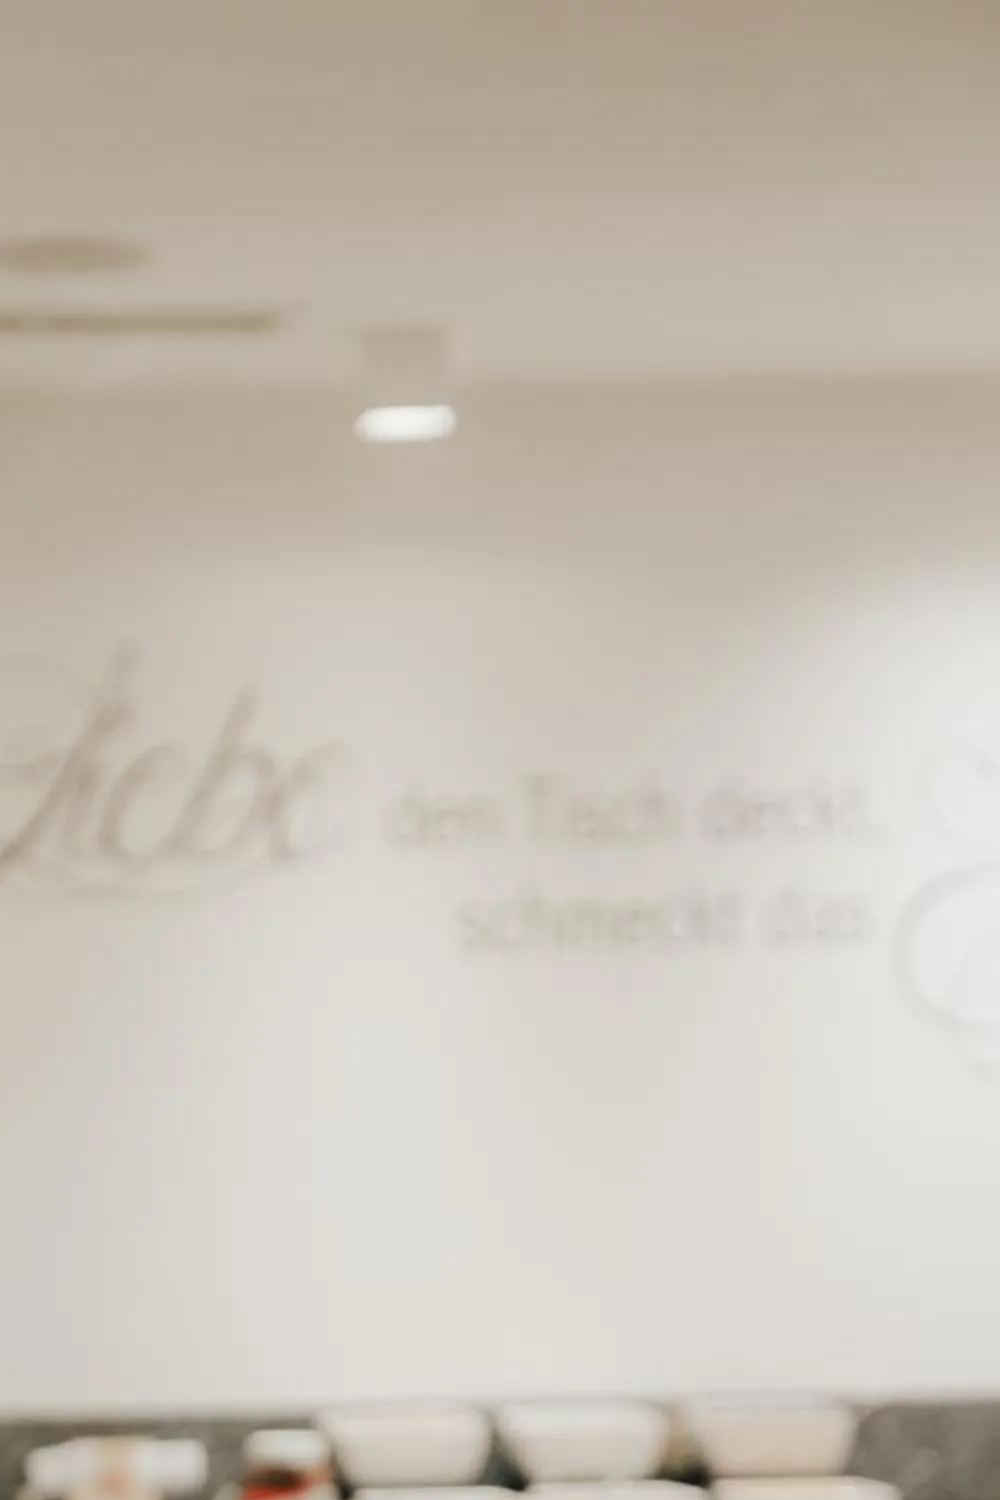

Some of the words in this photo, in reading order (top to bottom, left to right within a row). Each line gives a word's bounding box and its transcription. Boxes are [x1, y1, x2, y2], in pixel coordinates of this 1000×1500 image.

[383, 784, 504, 851] den
[519, 773, 682, 848] Tisch
[456, 884, 744, 950] schmeckt
